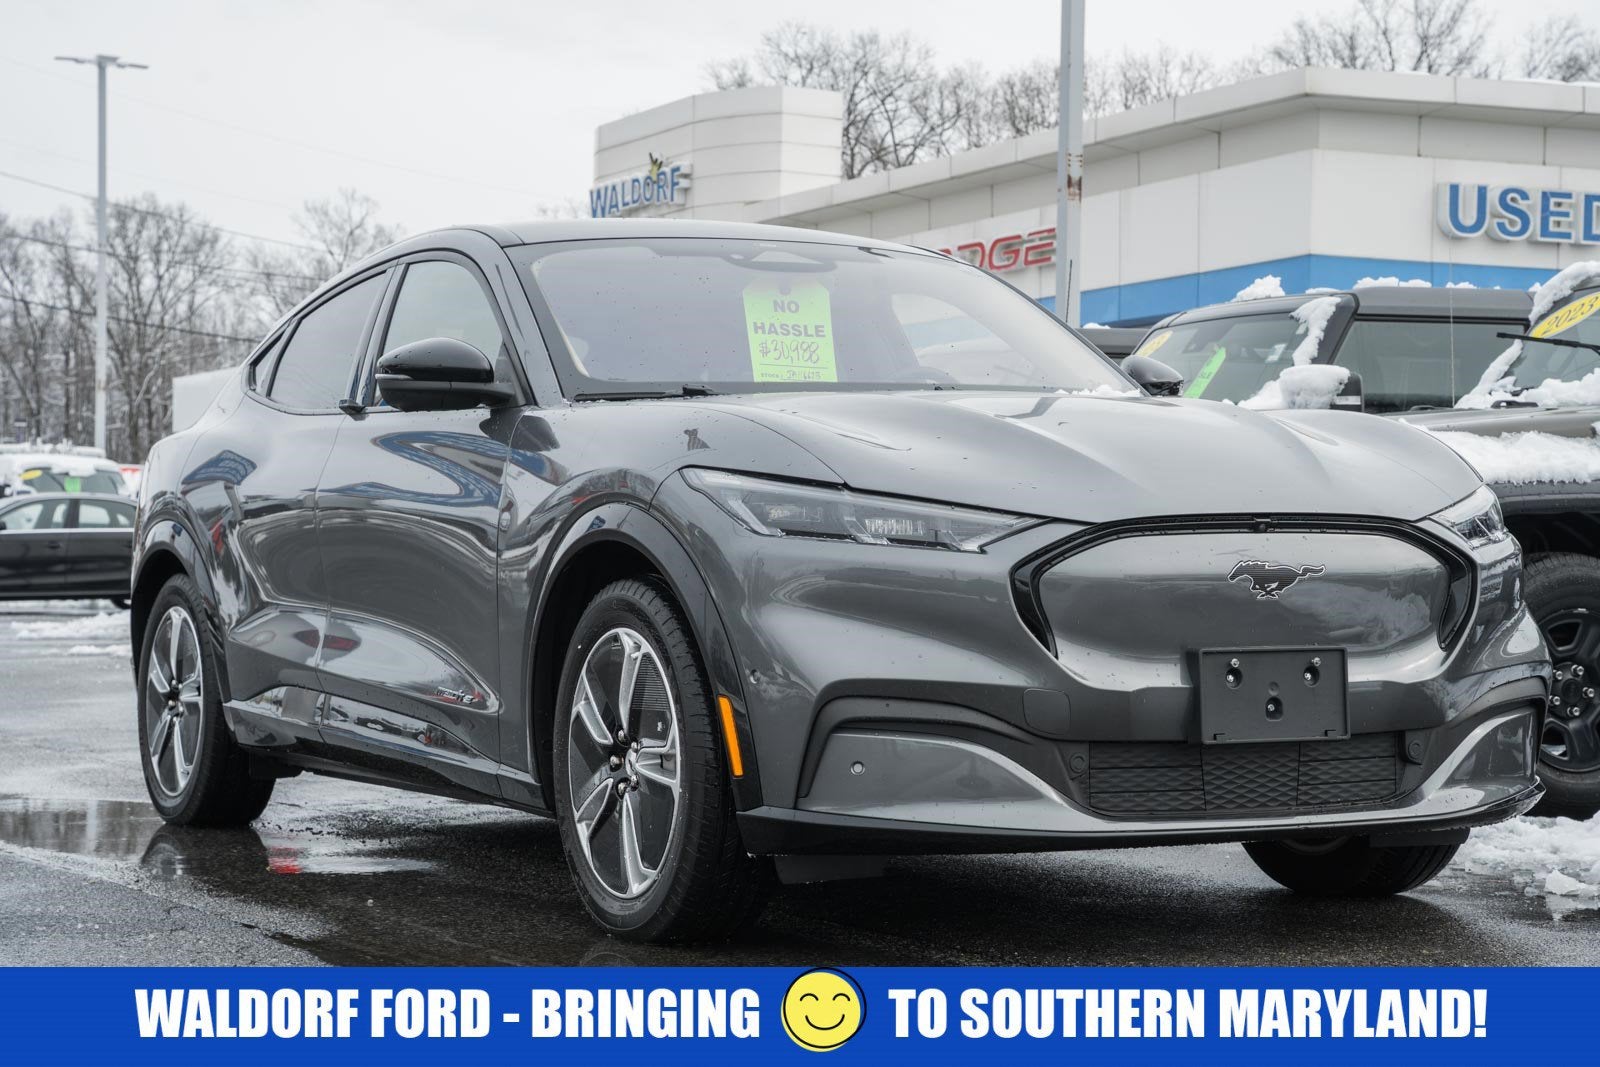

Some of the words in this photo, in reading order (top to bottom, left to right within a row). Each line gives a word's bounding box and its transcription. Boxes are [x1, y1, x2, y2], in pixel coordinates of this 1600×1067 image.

[589, 165, 681, 218] WALDORF
[1449, 183, 1600, 242] USED
[937, 228, 1056, 270] DGE
[773, 299, 800, 313] NO
[1540, 296, 1599, 336] 2023
[753, 321, 826, 338] HASSLE
